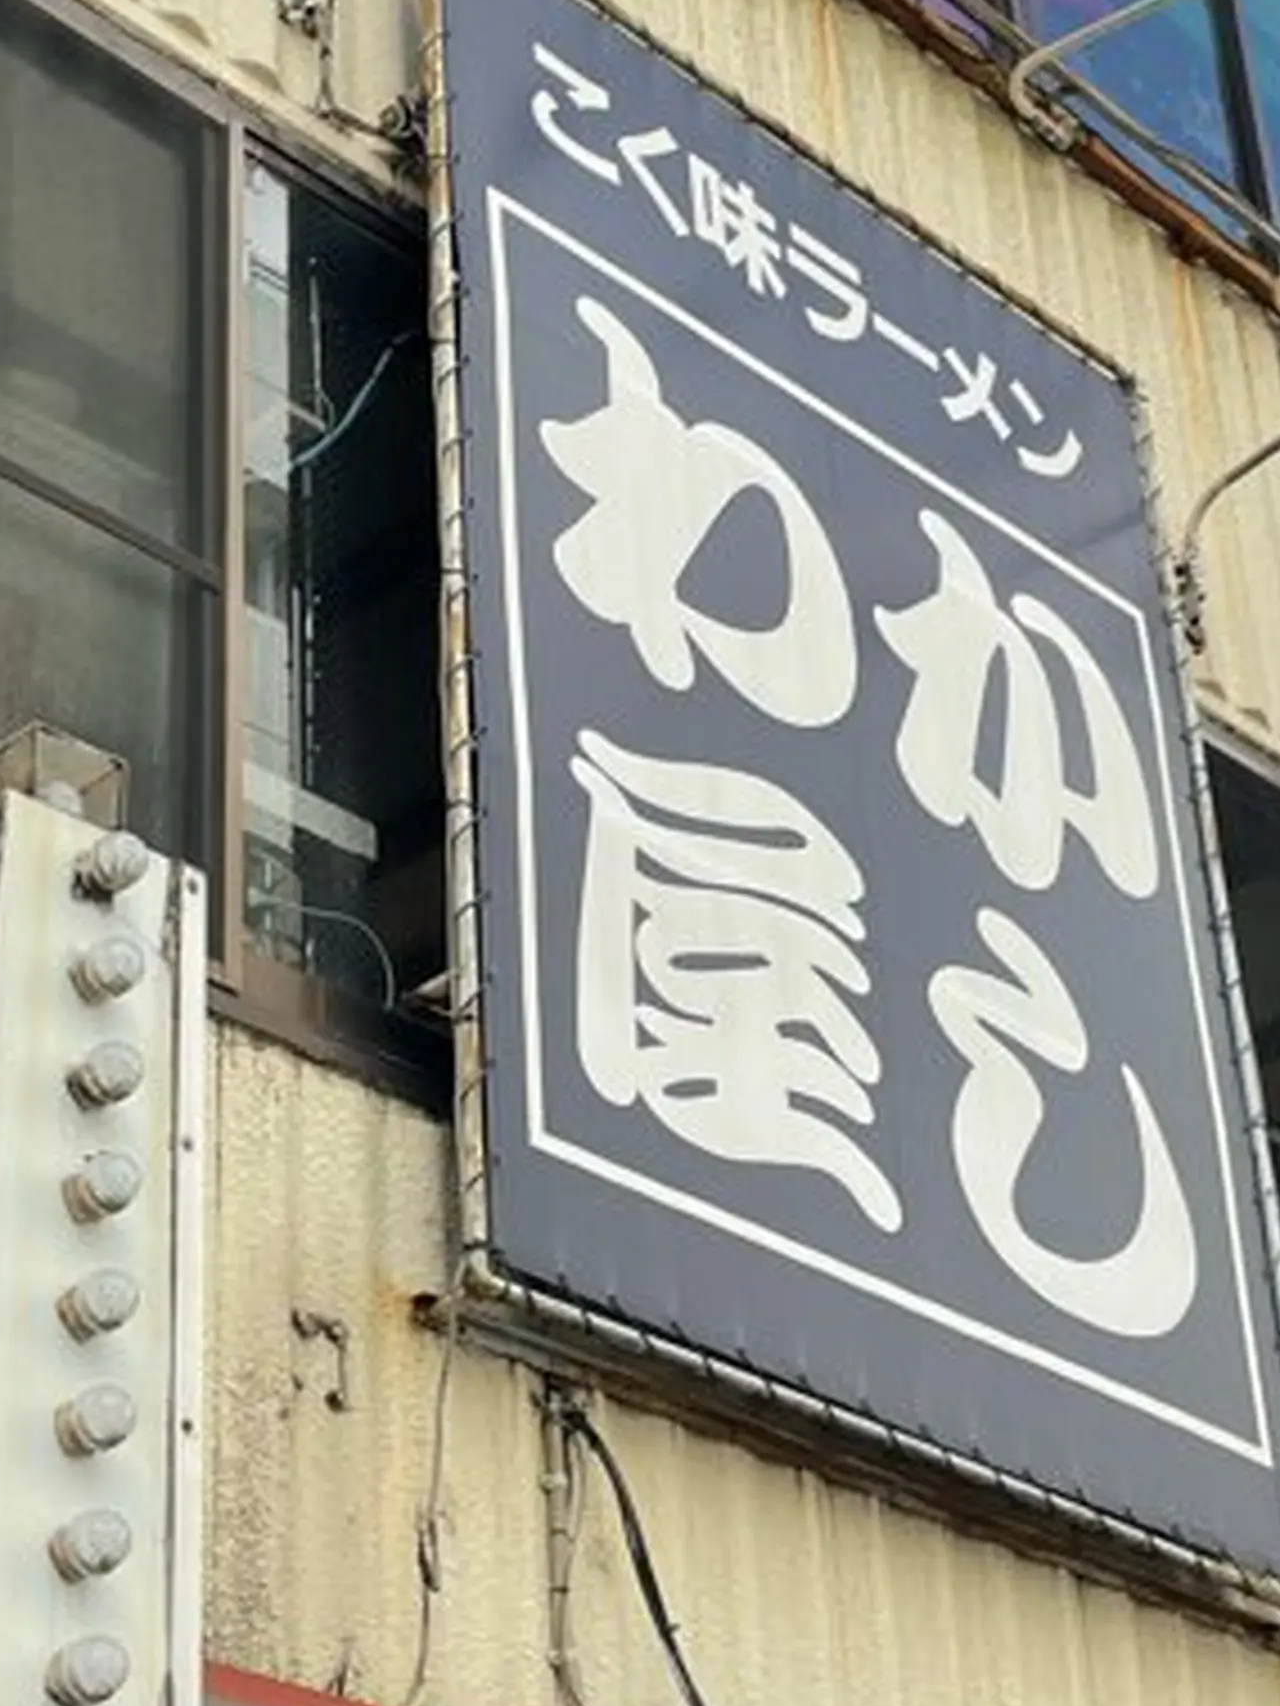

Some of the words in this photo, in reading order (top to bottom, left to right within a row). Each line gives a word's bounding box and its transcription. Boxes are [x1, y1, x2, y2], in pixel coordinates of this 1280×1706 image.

[531, 43, 1084, 479] こく味ラーメン
